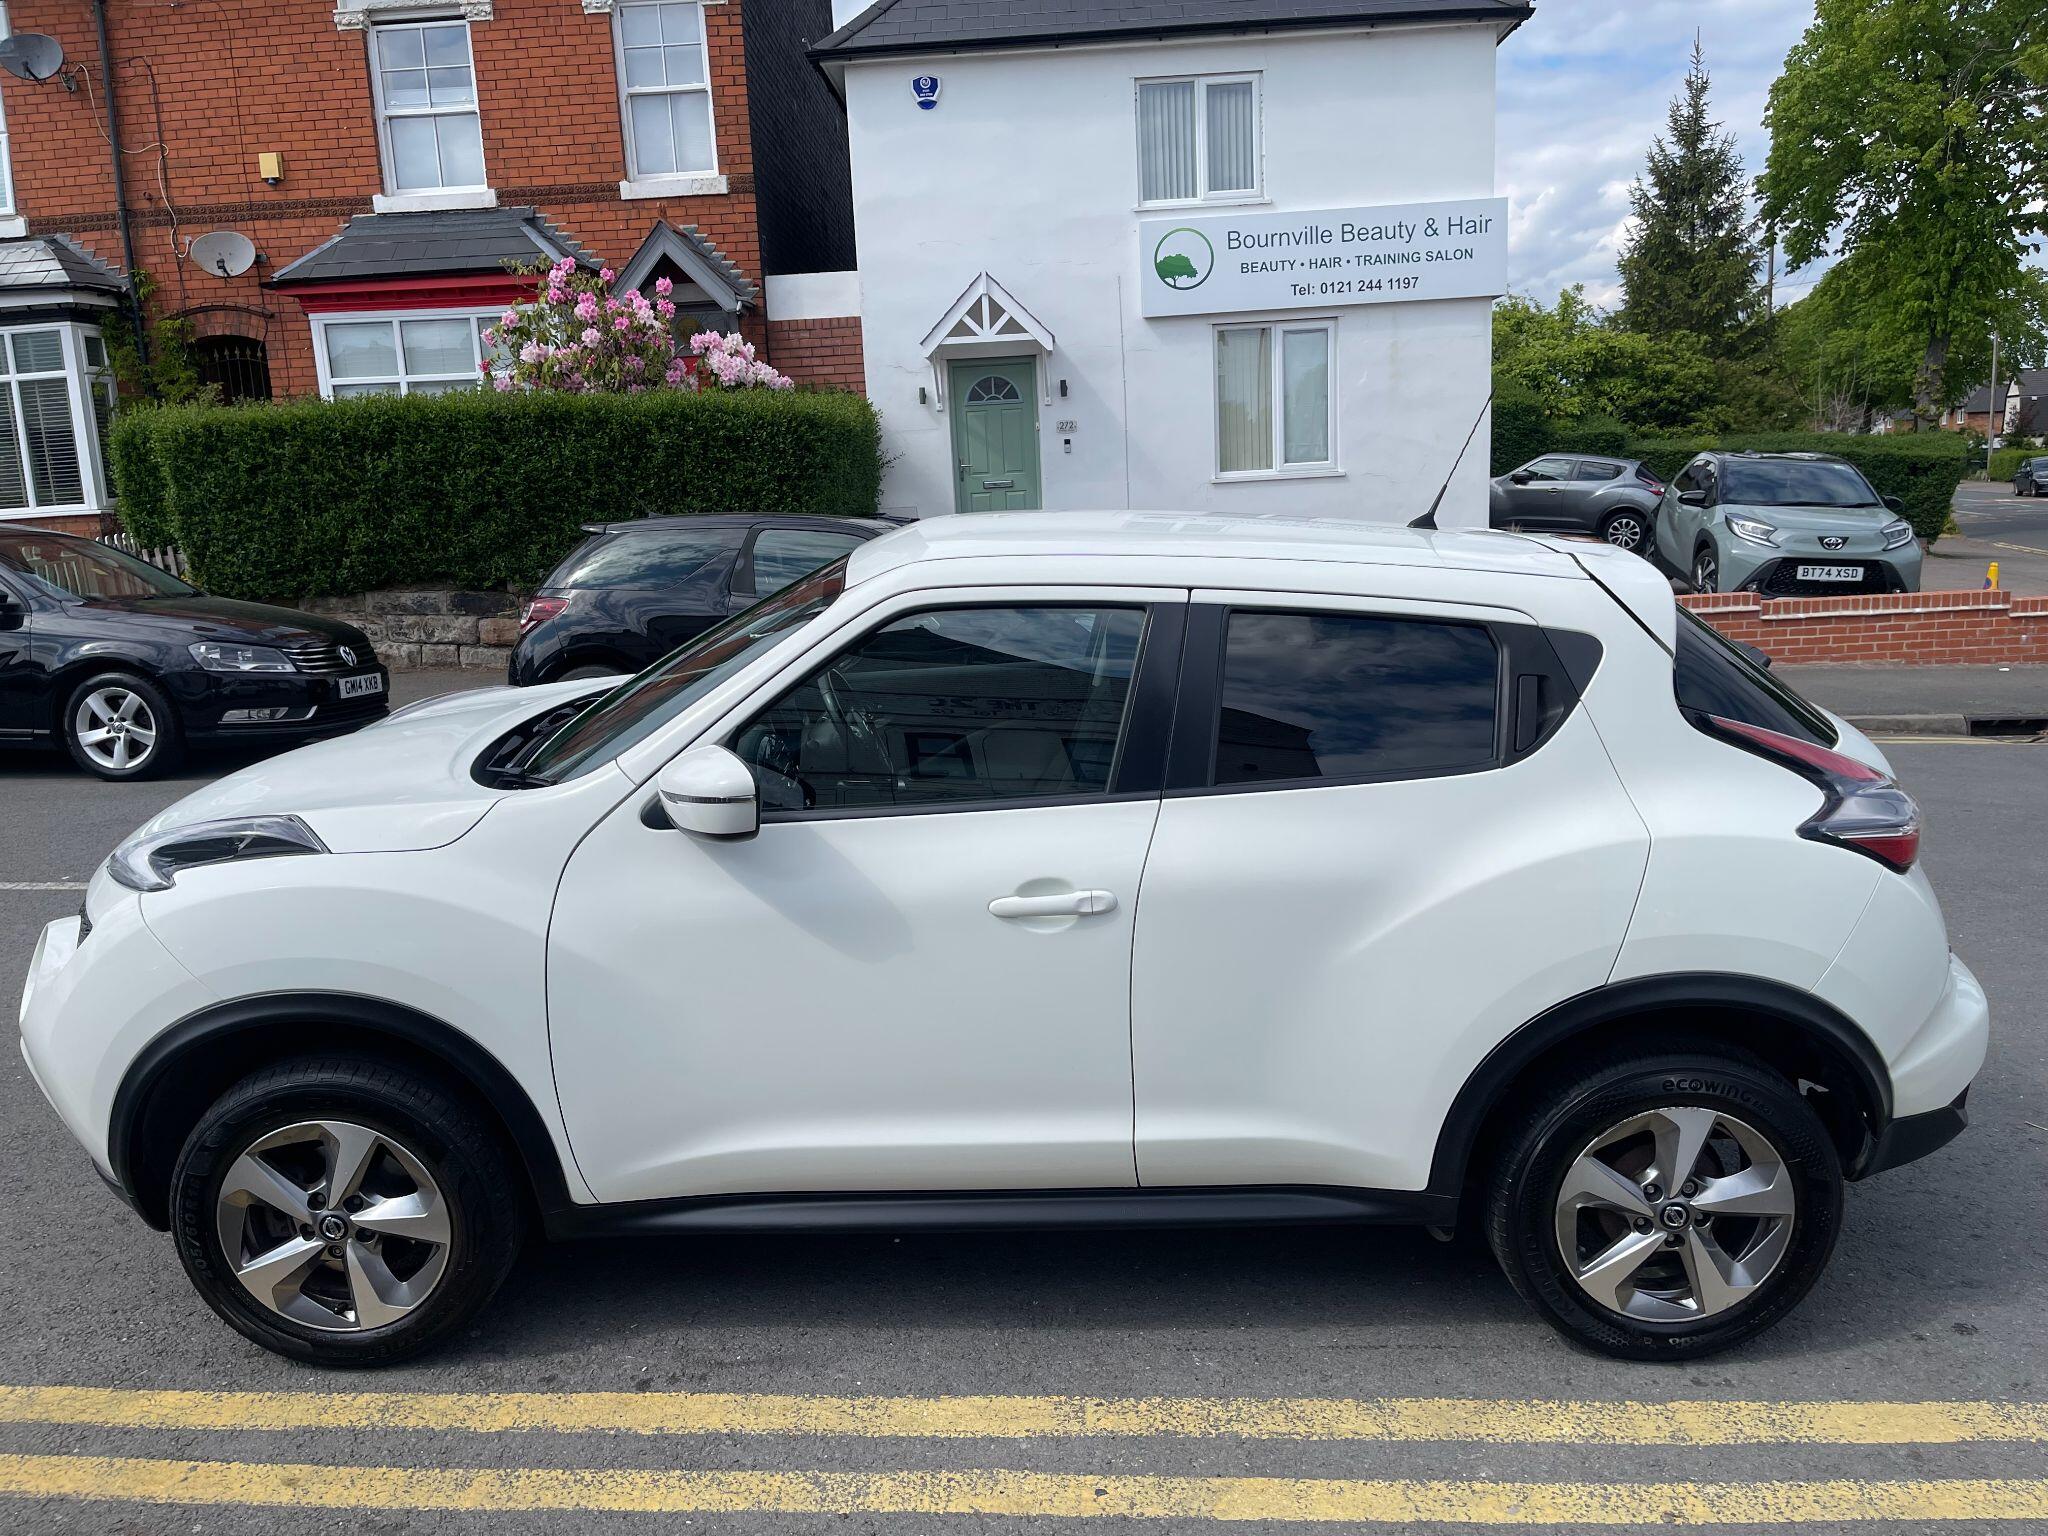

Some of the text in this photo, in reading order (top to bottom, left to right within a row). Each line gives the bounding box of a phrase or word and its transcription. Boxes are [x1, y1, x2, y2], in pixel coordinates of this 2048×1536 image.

[1227, 214, 1493, 249] Bournville Beauty & Hair
[1240, 248, 1473, 274] BEAUTY HAIR TRAINING SALON
[1290, 276, 1419, 296] Tel: 0121 244 1197
[1059, 421, 1074, 430] 272
[1802, 567, 1858, 578] BT74 XSD
[363, 675, 379, 691] XKB
